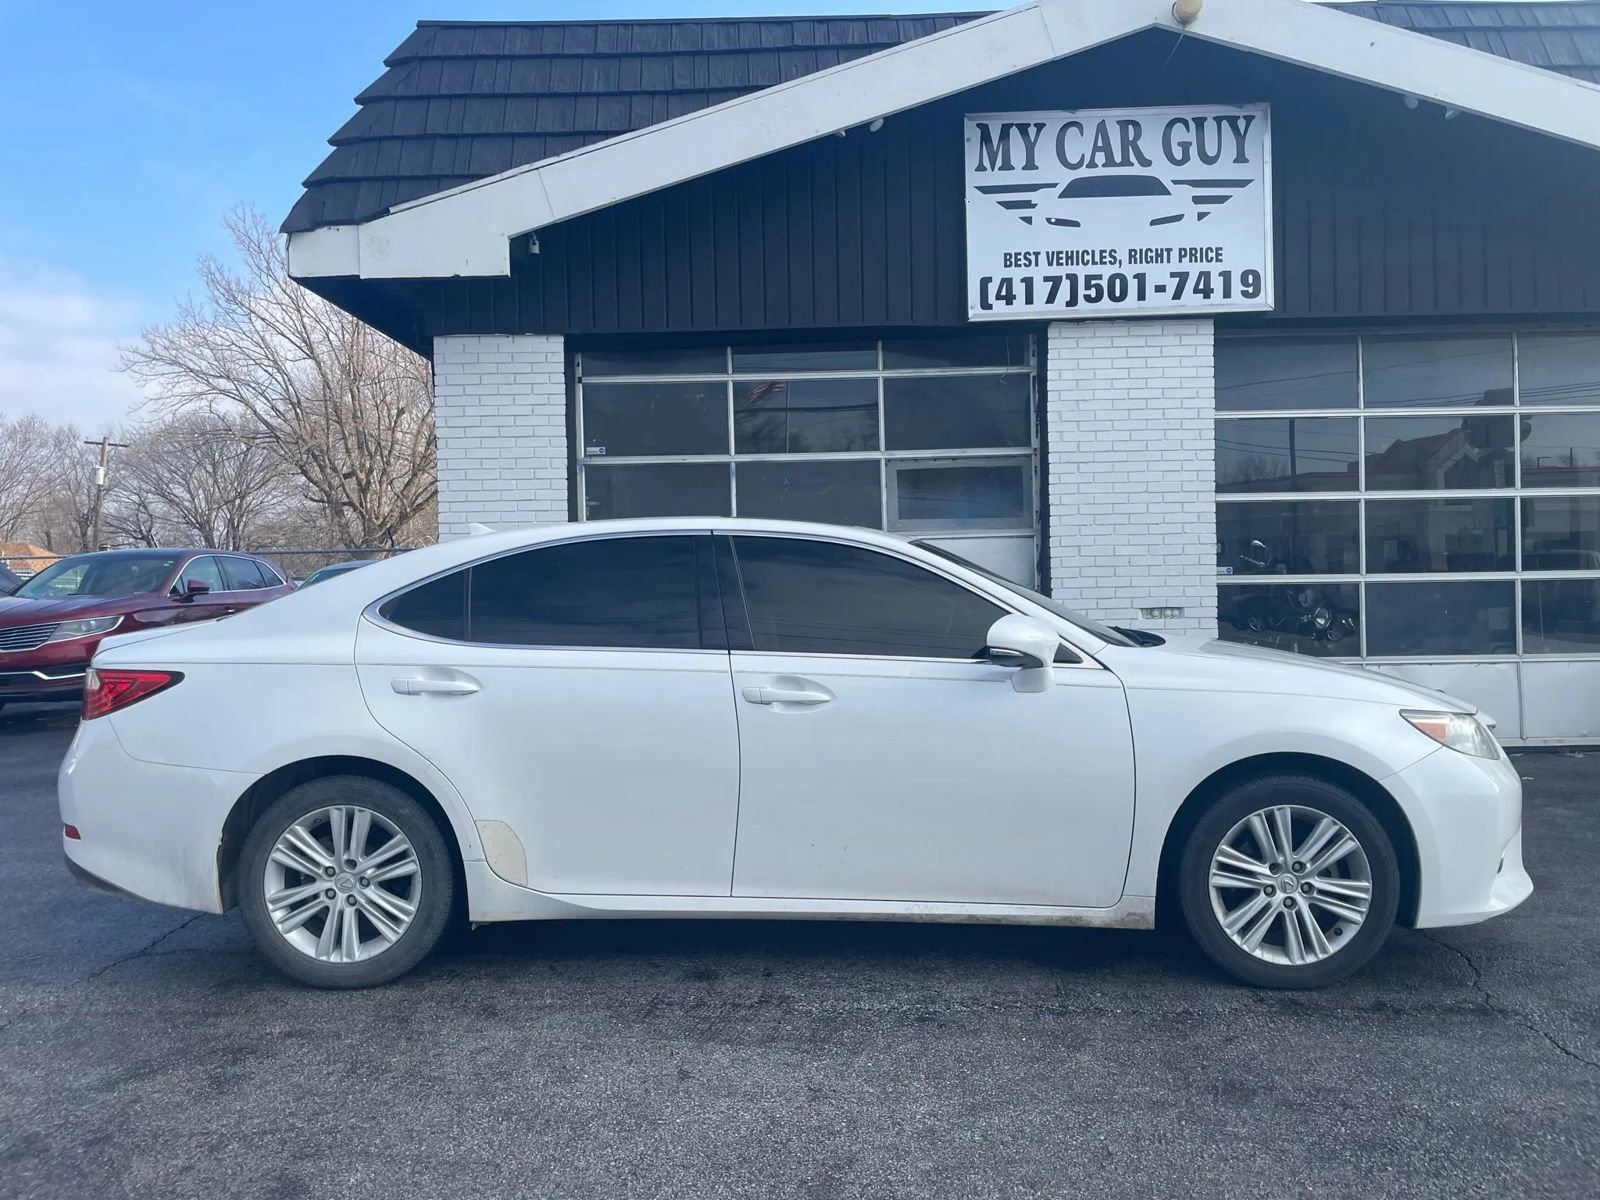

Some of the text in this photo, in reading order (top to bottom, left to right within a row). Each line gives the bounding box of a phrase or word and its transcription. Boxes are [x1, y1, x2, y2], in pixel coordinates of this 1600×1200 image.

[974, 115, 1256, 172] MY CAR GUY
[1003, 246, 1224, 268] BEST VEHICLES, RIGHT PRICE
